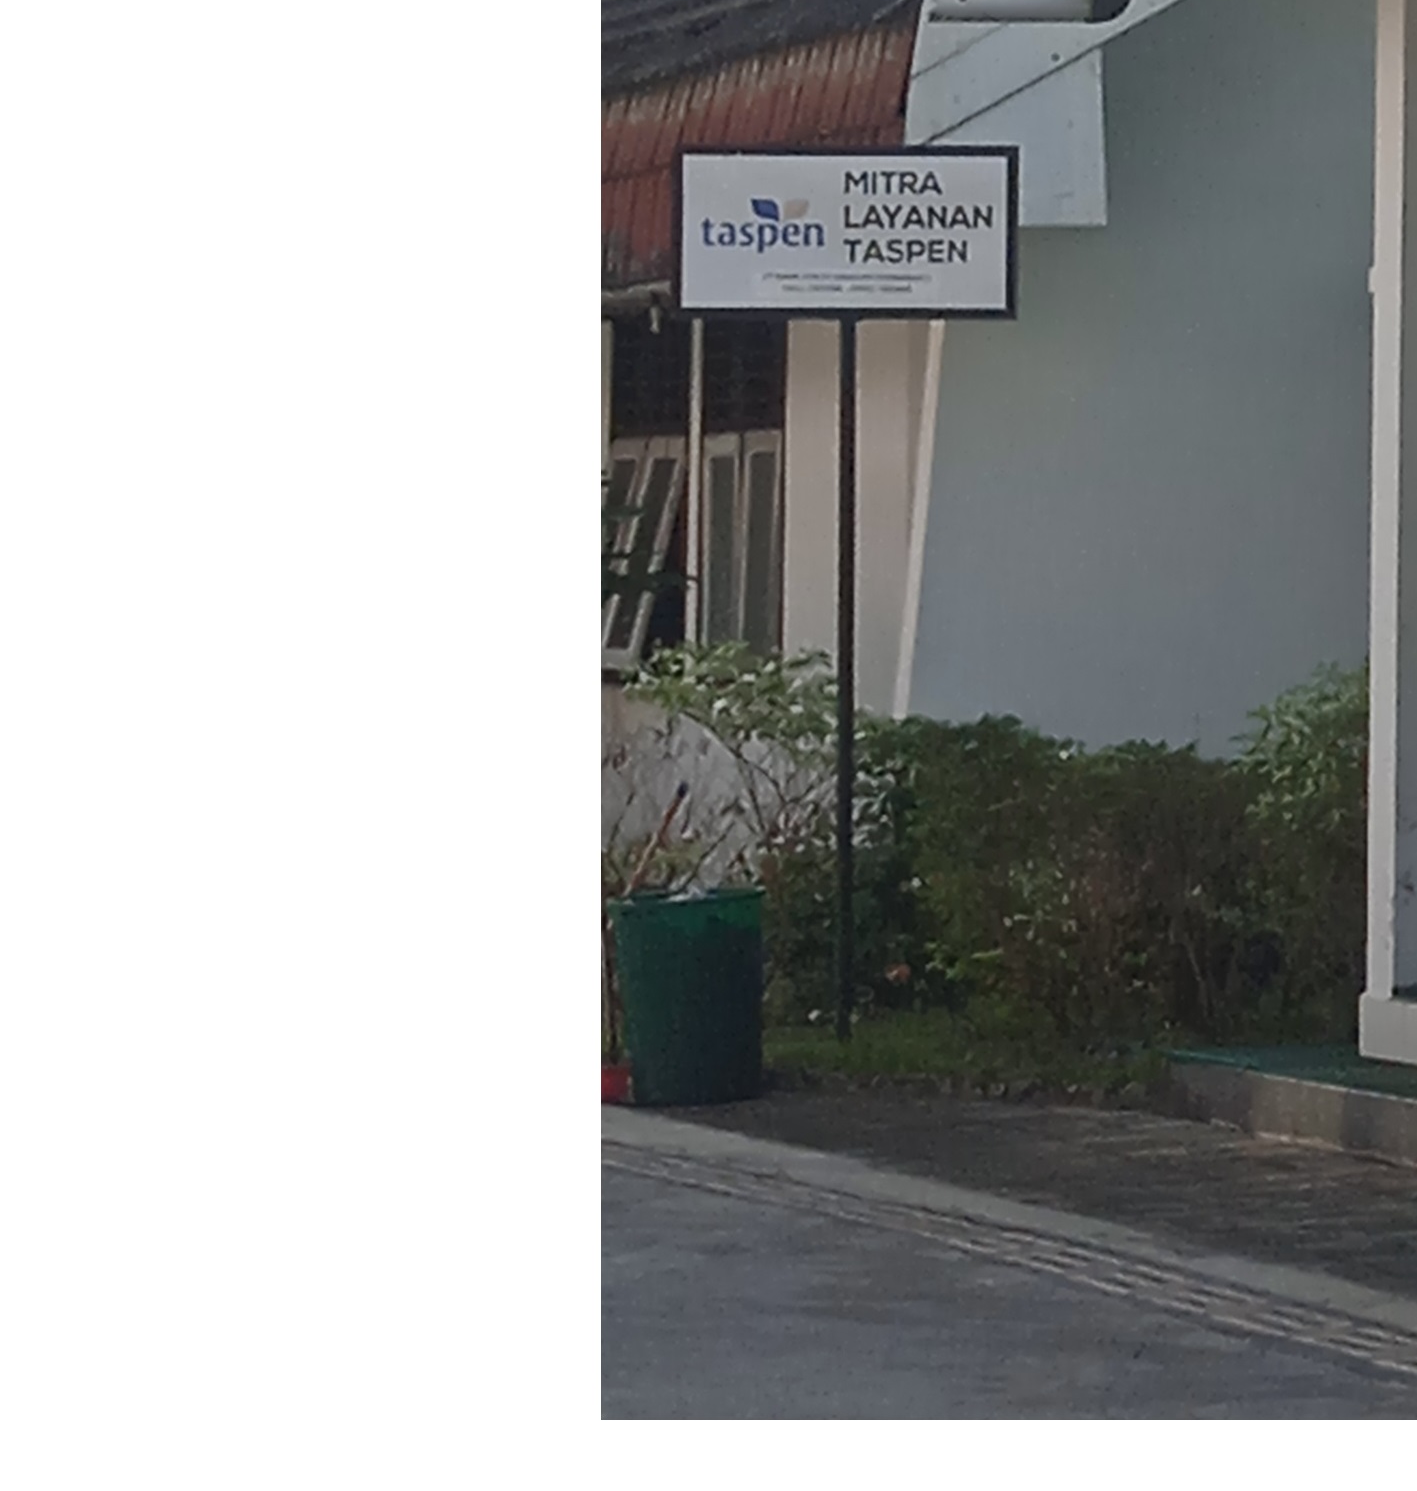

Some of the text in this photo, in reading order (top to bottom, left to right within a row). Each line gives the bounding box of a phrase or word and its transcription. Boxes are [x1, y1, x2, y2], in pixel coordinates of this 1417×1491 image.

[843, 170, 943, 196] MITRA
[843, 203, 994, 230] LAYANAN
[700, 216, 826, 254] taspen
[843, 237, 969, 264] TASPEN
